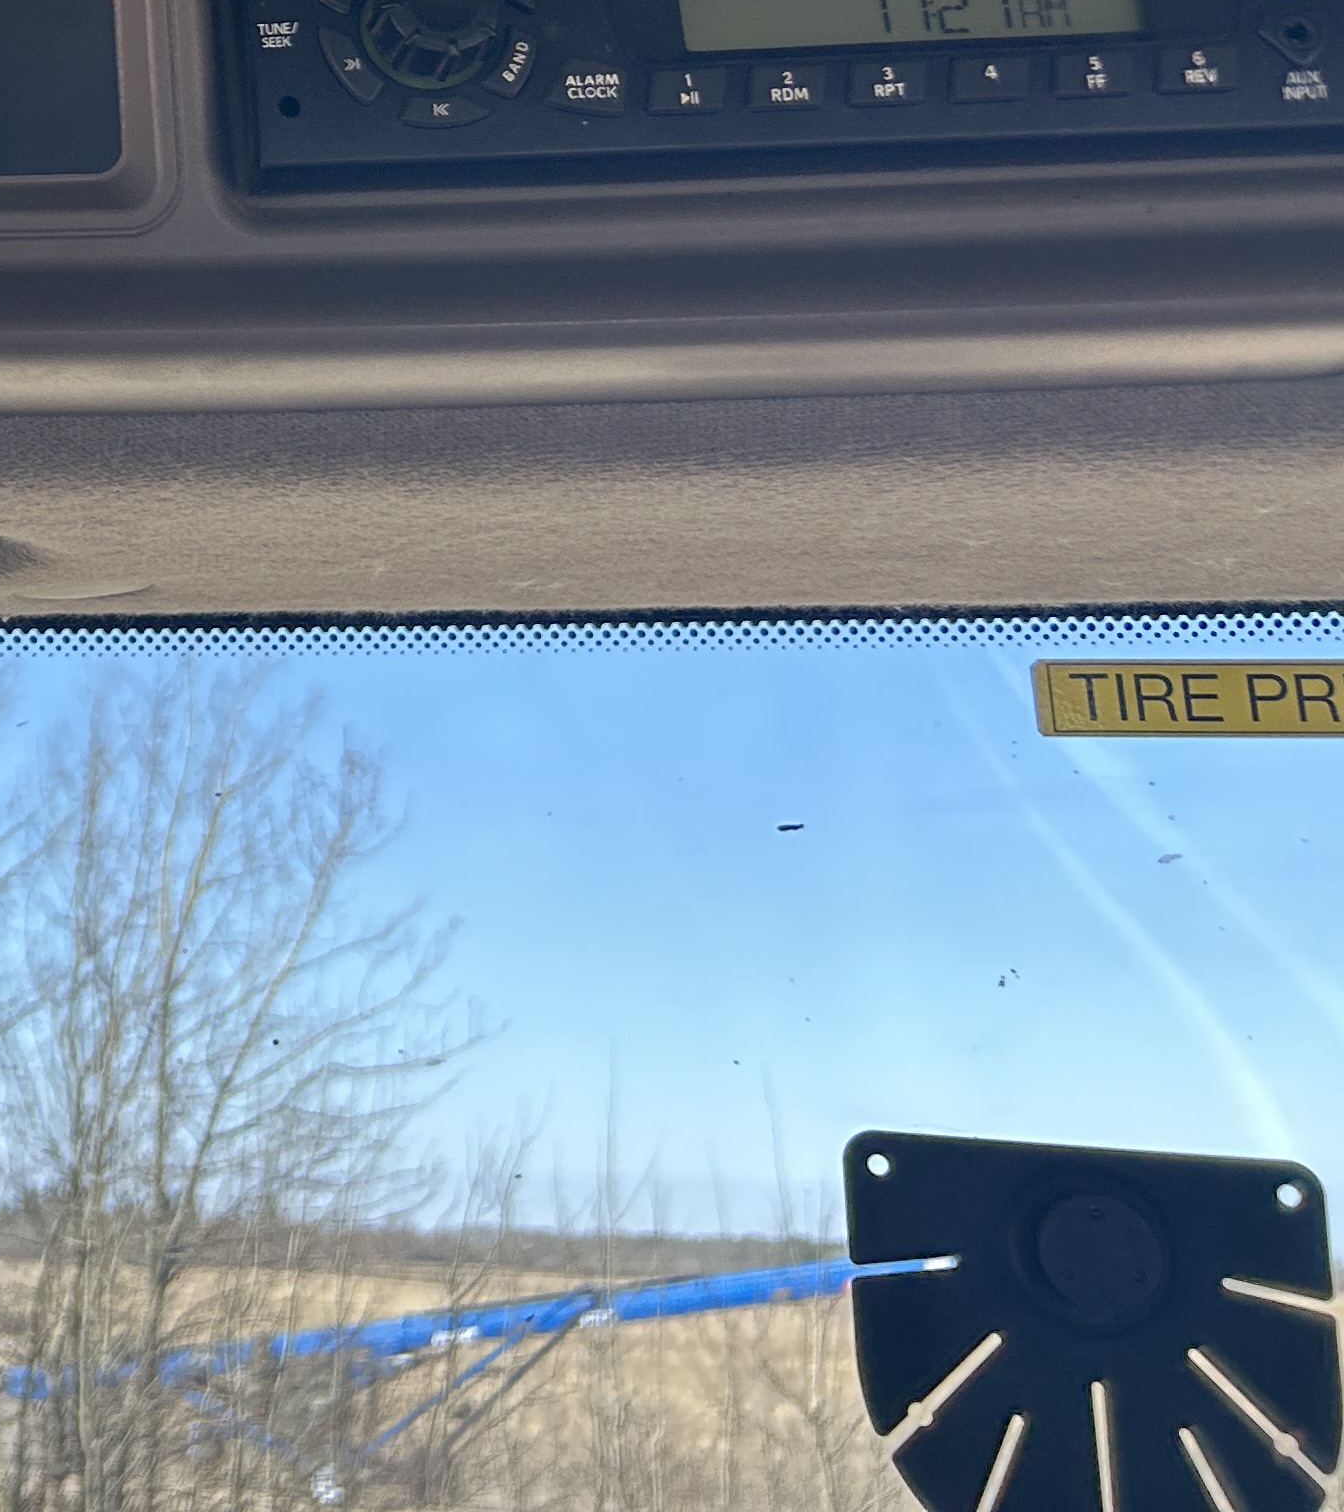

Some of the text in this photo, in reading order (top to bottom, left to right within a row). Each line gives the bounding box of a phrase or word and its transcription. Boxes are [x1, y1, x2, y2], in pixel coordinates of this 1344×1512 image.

[257, 21, 300, 37] TUNE/
[261, 35, 294, 49] SEEK
[502, 41, 529, 83] BAND
[1087, 55, 1103, 71] 5
[1191, 50, 1207, 66] 6
[565, 73, 621, 87] ALARM
[782, 71, 793, 85] 2
[882, 66, 894, 81] 3
[983, 64, 999, 80] 4
[1184, 68, 1218, 86] REV
[1286, 69, 1323, 85] AUX
[684, 73, 692, 88] 1
[1086, 73, 1108, 90] FF
[567, 86, 618, 100] CLOCK
[771, 87, 810, 103] RDM
[873, 82, 907, 99] RPT
[1281, 84, 1329, 101] INPUT
[1068, 672, 1344, 723] TIRE PR
